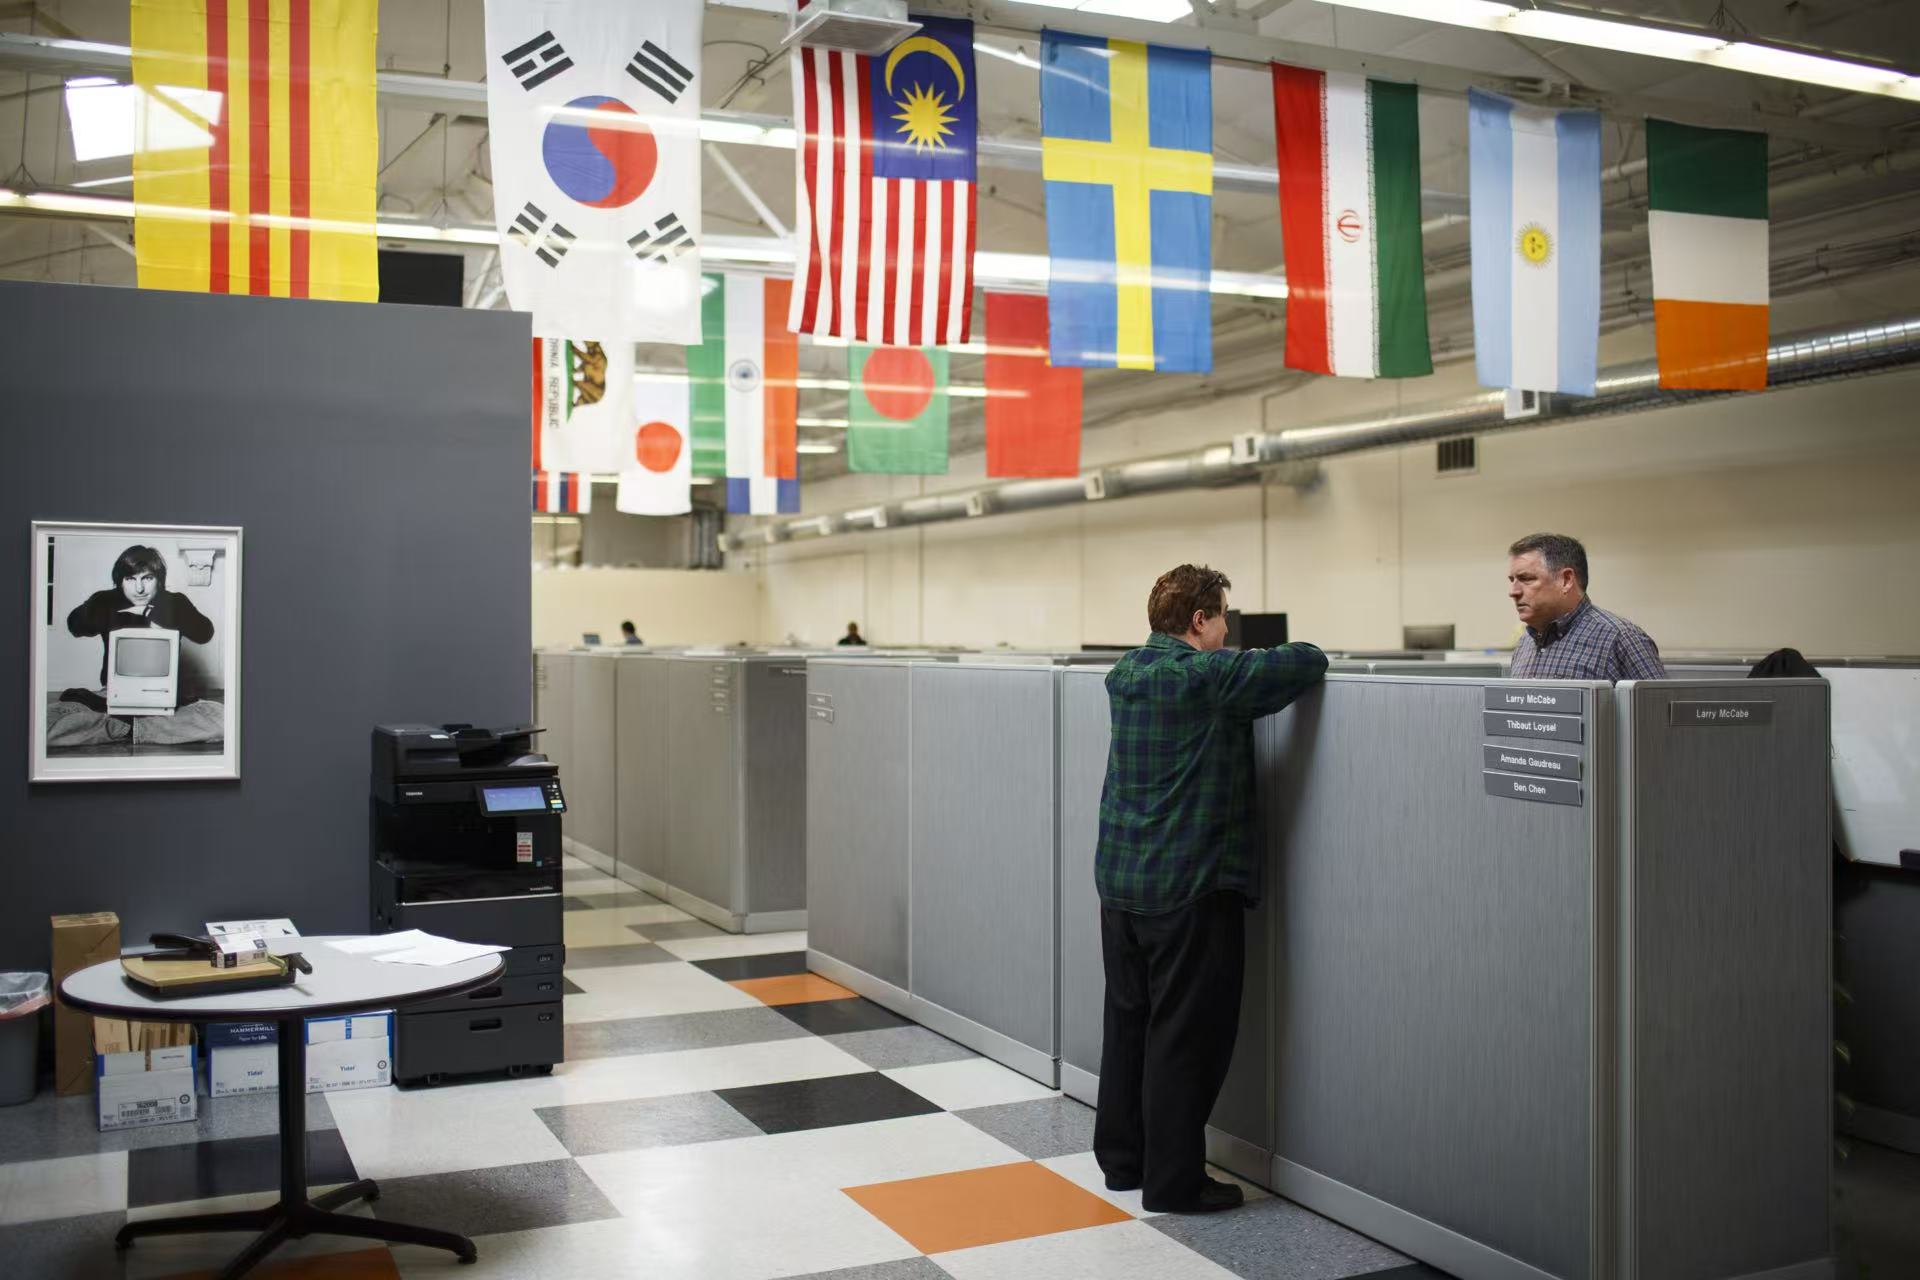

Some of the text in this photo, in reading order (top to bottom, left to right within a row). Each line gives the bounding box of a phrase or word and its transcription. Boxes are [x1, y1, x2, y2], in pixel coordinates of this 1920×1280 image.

[548, 376, 560, 430] REPUBLIC
[1505, 693, 1557, 705] Larry McCabe
[1696, 708, 1749, 720] Larry McCabe
[1506, 720, 1557, 733] Thibaut Loysel
[1500, 753, 1561, 770] Amanda Gaudreau
[1513, 782, 1546, 794] Ben Chen
[230, 1026, 276, 1034] HAMMERMILL
